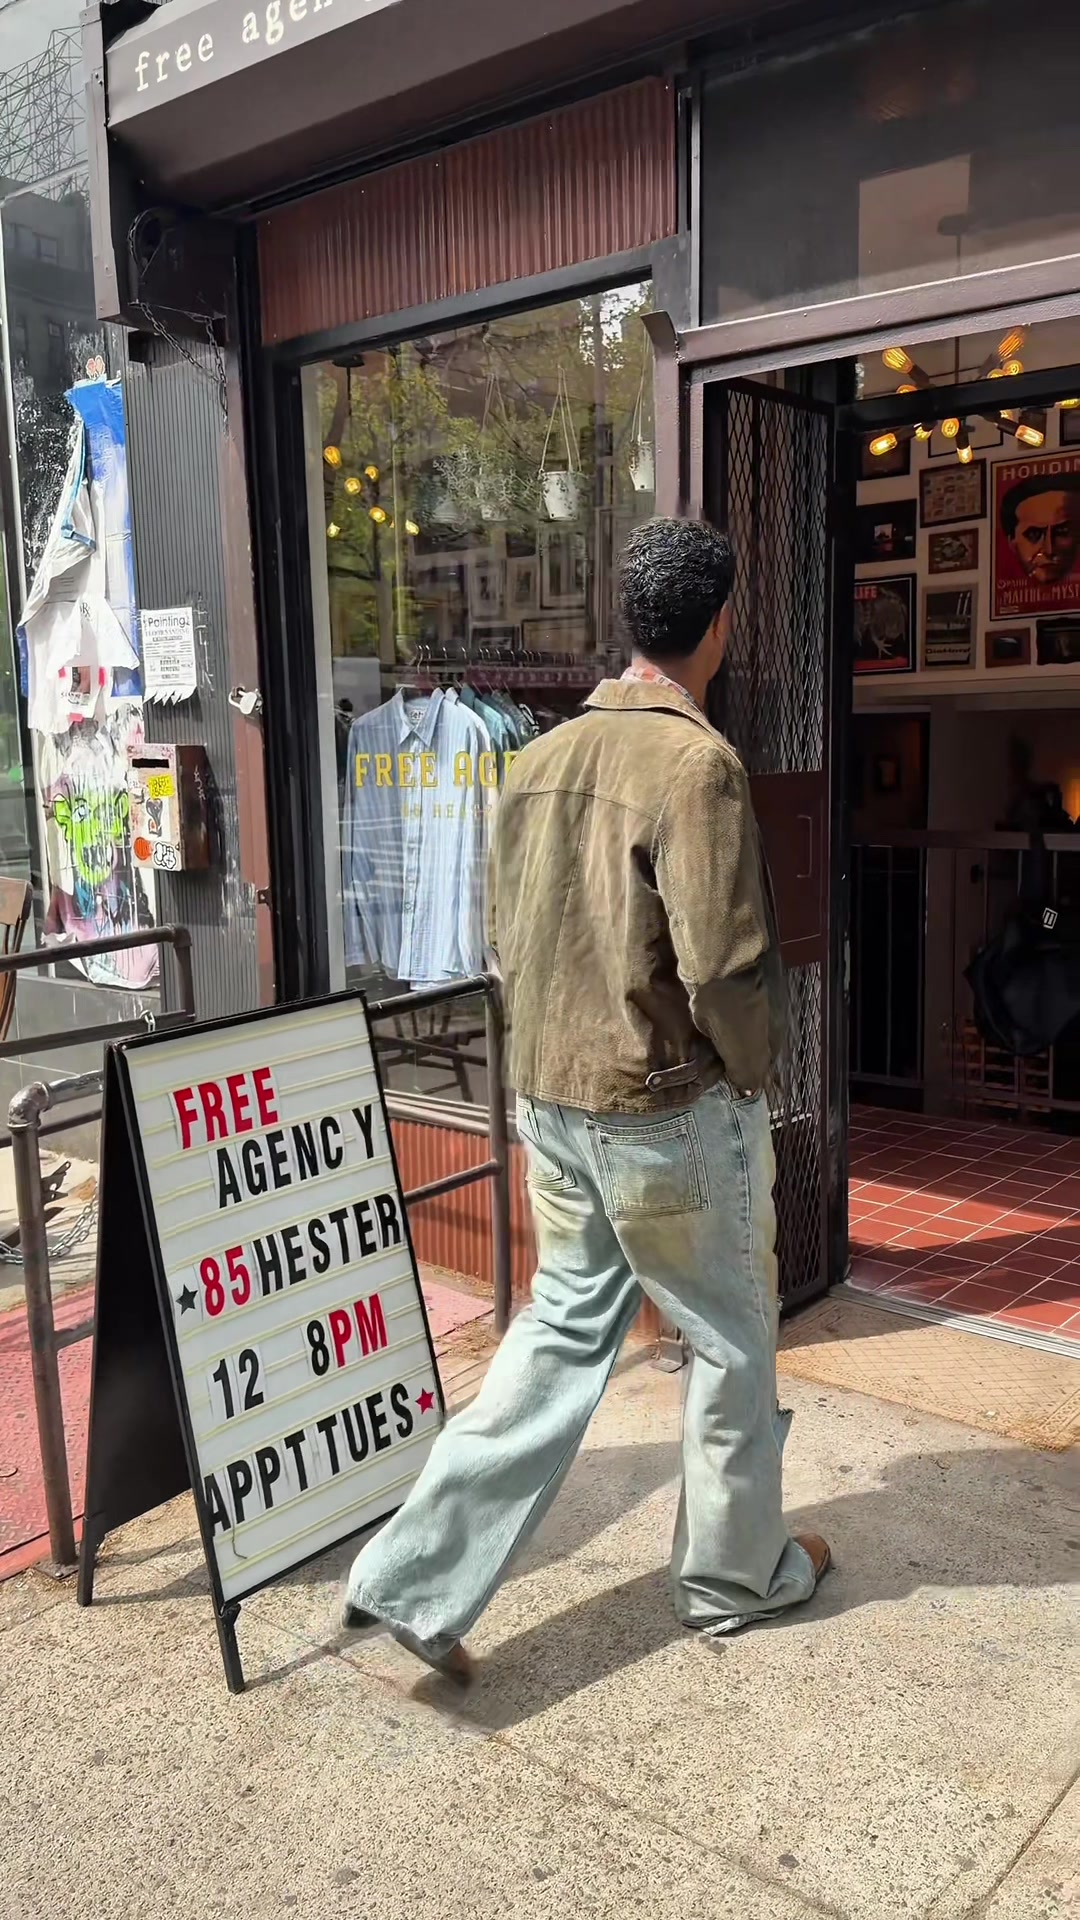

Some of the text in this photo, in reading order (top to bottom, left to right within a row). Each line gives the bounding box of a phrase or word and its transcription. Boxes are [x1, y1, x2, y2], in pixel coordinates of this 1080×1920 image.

[134, 0, 372, 92] free agen
[854, 586, 878, 600] LIFE
[354, 751, 438, 788] FREE
[173, 1067, 279, 1150] FREE
[216, 1104, 375, 1209] AGENCY
[212, 1293, 389, 1420] 12 8PM
[203, 1383, 414, 1534] APPT TUES
